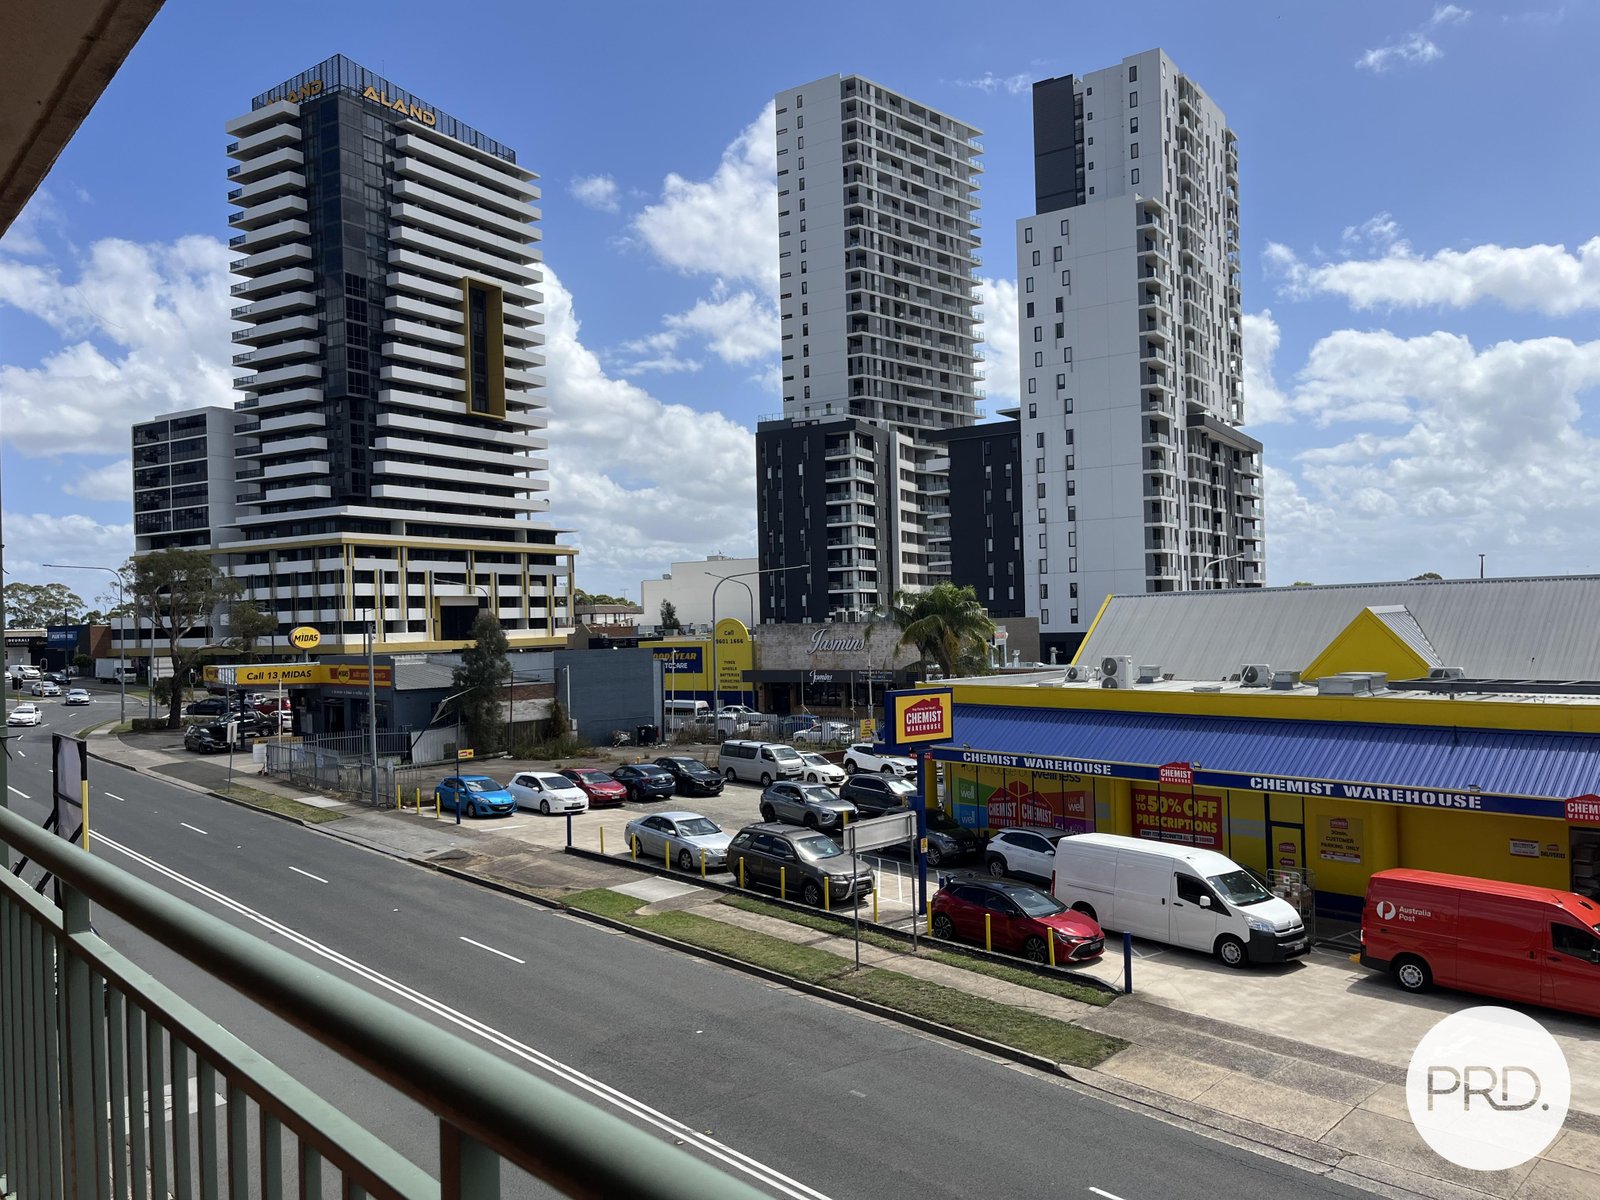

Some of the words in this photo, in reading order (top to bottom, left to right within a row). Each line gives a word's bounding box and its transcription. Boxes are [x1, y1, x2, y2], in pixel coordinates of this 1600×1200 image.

[362, 84, 436, 126] ALAND
[294, 632, 319, 642] MIDAS
[805, 628, 865, 655] Jasmins
[247, 672, 264, 680] Call
[267, 671, 278, 680] 13
[281, 669, 312, 679] MIDAS
[906, 710, 942, 725] CHEMIST
[906, 723, 941, 732] WAREHOUSE
[963, 752, 1018, 766] CHEMIST
[1024, 757, 1112, 775] WAREHOUSE
[1160, 769, 1192, 779] CHEMIST
[960, 785, 975, 799] well
[1135, 794, 1146, 802] UP
[1250, 777, 1335, 796] CHEMIST
[1344, 784, 1482, 809] WAREHOUSE
[988, 802, 1017, 818] CHEMIST
[1068, 796, 1085, 812] well
[1135, 802, 1147, 811] TO
[1147, 795, 1182, 813] 50%
[1183, 798, 1218, 818] OFF
[961, 810, 976, 824] well
[1021, 803, 1052, 823] CHEMIST
[1136, 813, 1218, 833] PRESCRIPTIONS
[1398, 905, 1431, 917] Australia
[1398, 913, 1416, 922] Post
